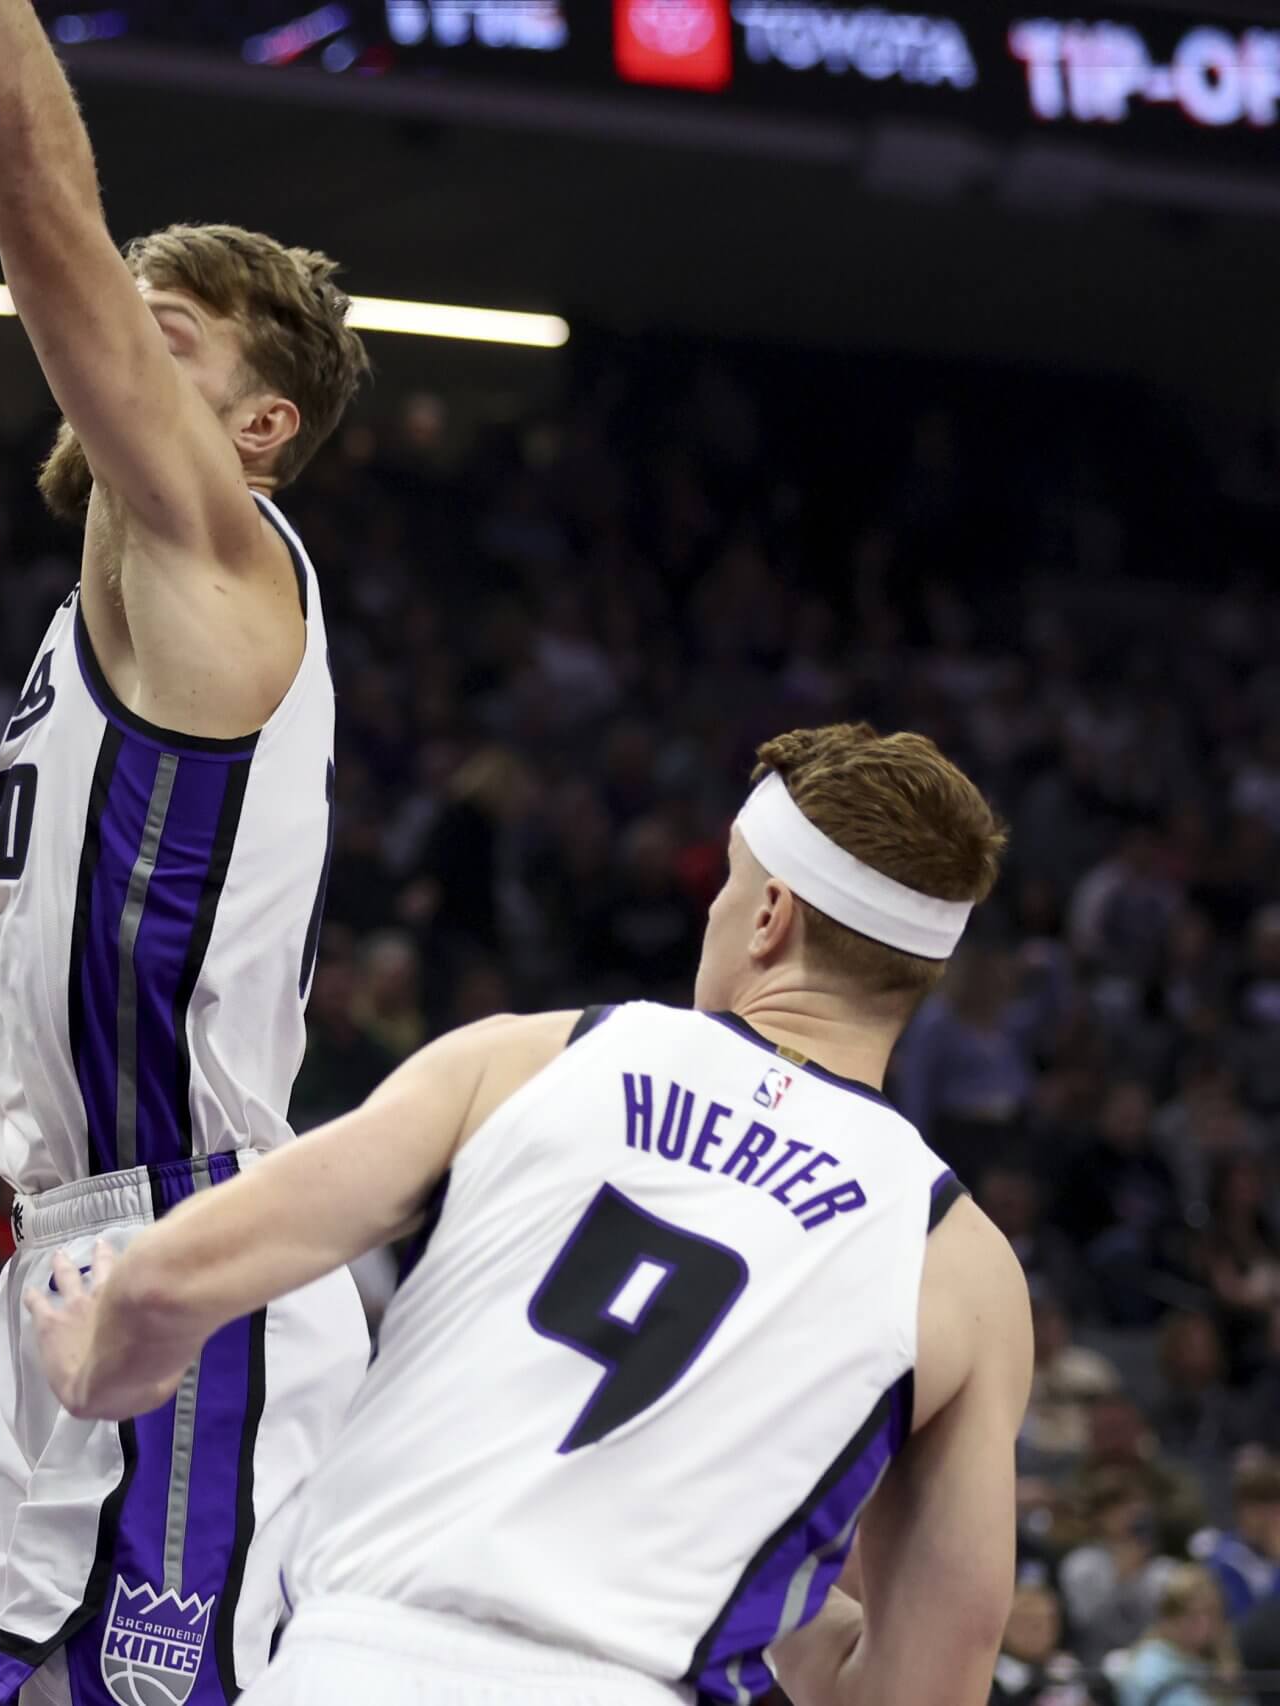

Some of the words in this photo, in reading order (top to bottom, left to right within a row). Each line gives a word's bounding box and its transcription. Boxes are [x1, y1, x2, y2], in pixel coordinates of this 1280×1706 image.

[622, 1072, 867, 1231] HUERTER
[527, 1181, 750, 1455] 9
[106, 1630, 200, 1673] KINGS
[115, 1615, 202, 1644] SACRAMENTO
